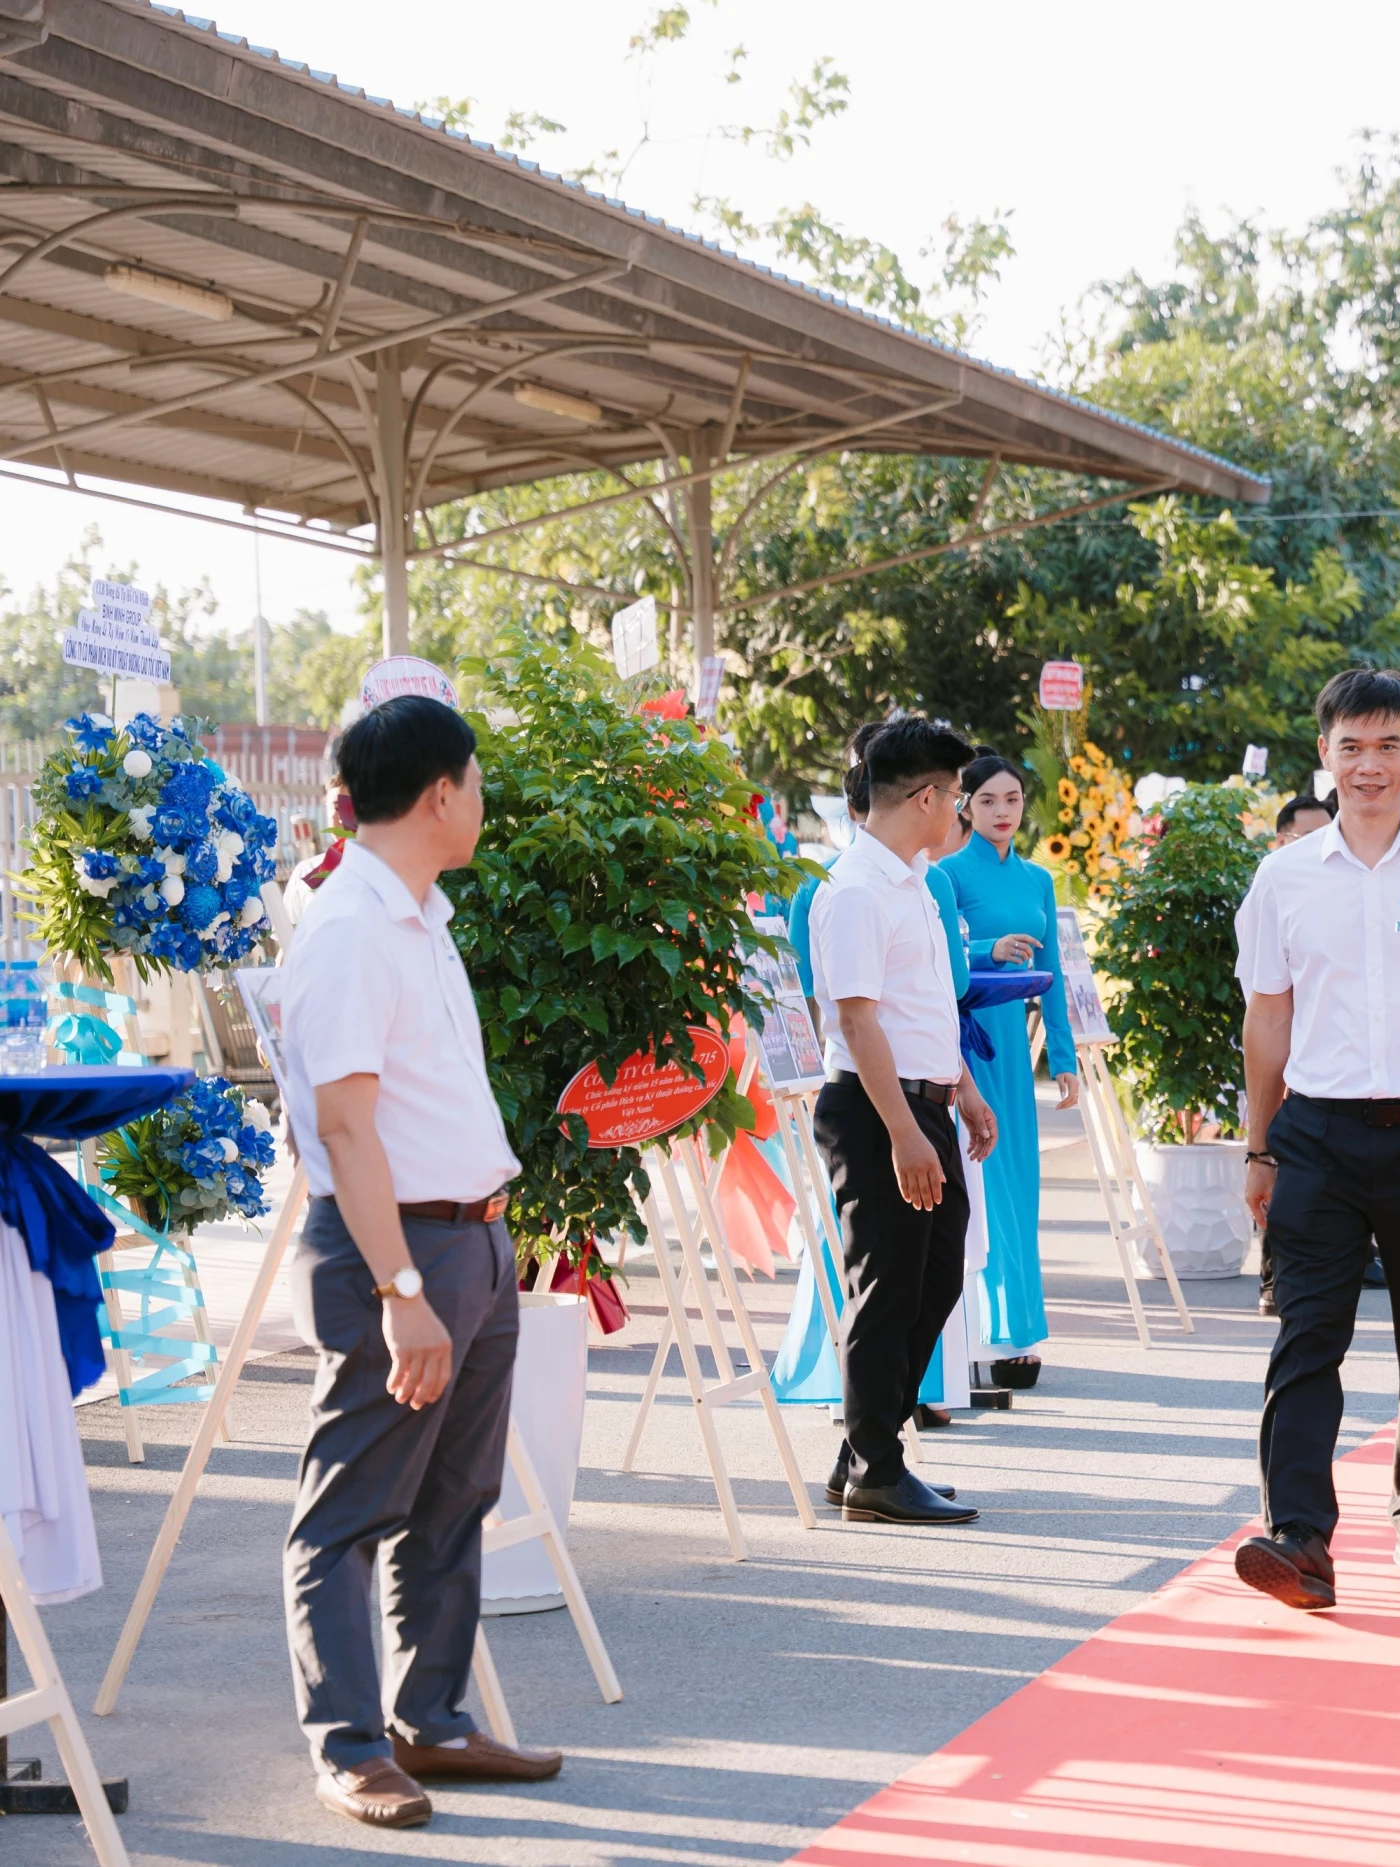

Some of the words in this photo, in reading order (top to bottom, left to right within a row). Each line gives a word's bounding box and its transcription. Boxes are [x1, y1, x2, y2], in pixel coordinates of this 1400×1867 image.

[126, 609, 142, 626] GROUP
[622, 1065, 641, 1081] TY
[699, 1051, 718, 1065] 715
[650, 1078, 660, 1088] 15
[582, 1106, 589, 1115] ty
[621, 1106, 635, 1118] Việt
